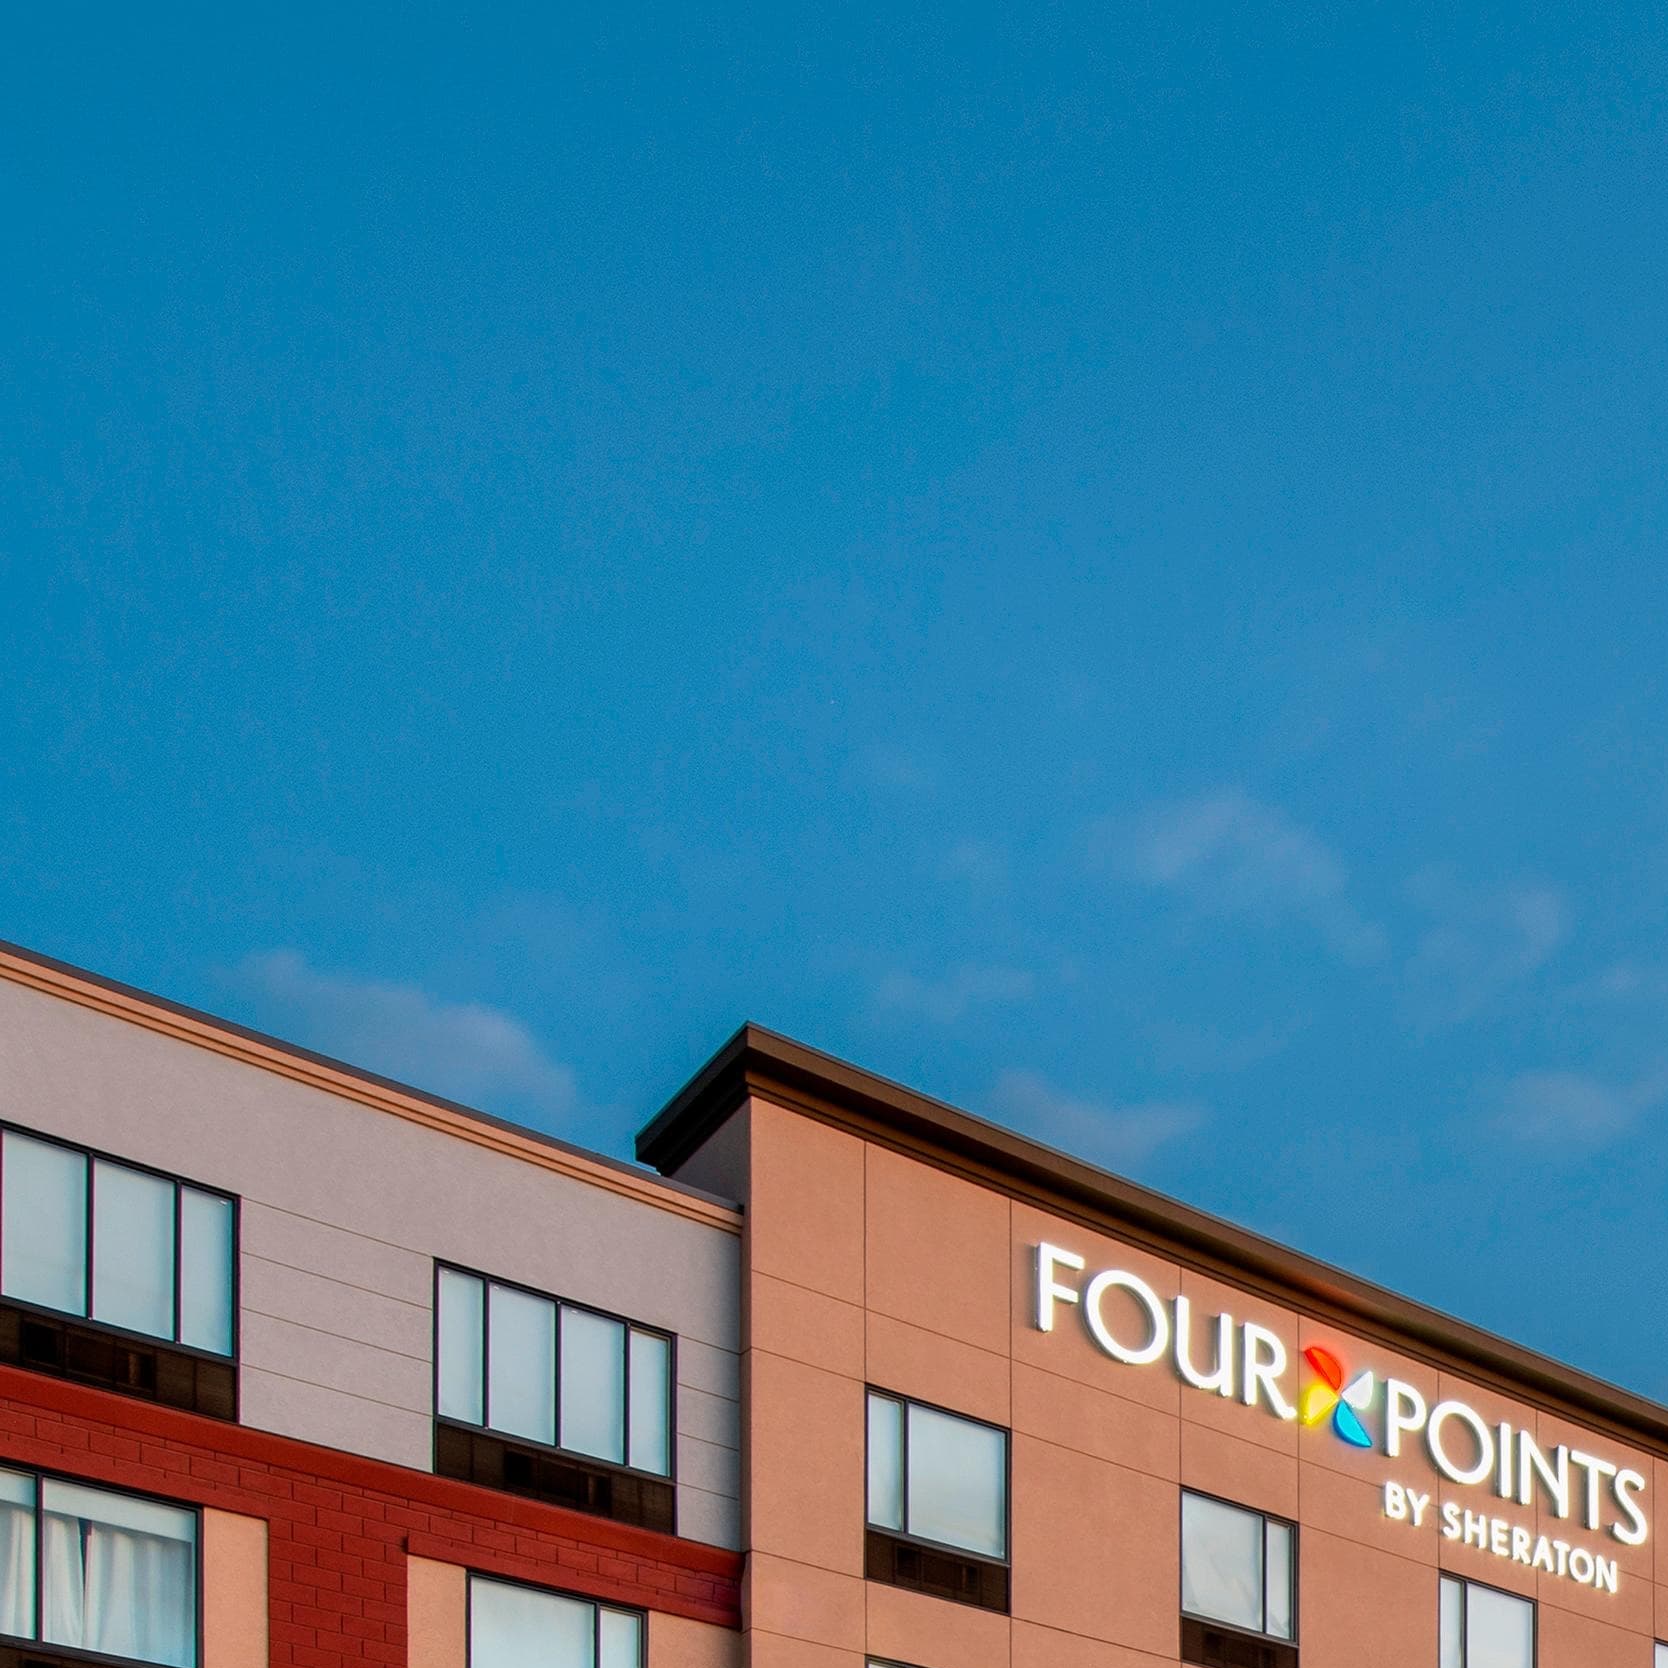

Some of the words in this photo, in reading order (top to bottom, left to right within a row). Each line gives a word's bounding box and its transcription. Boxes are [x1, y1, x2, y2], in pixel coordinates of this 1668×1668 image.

[1036, 1241, 1298, 1420] FOUR
[1385, 1378, 1649, 1546] POINTS
[1384, 1480, 1431, 1527] BY
[1440, 1501, 1619, 1595] SHERATON
